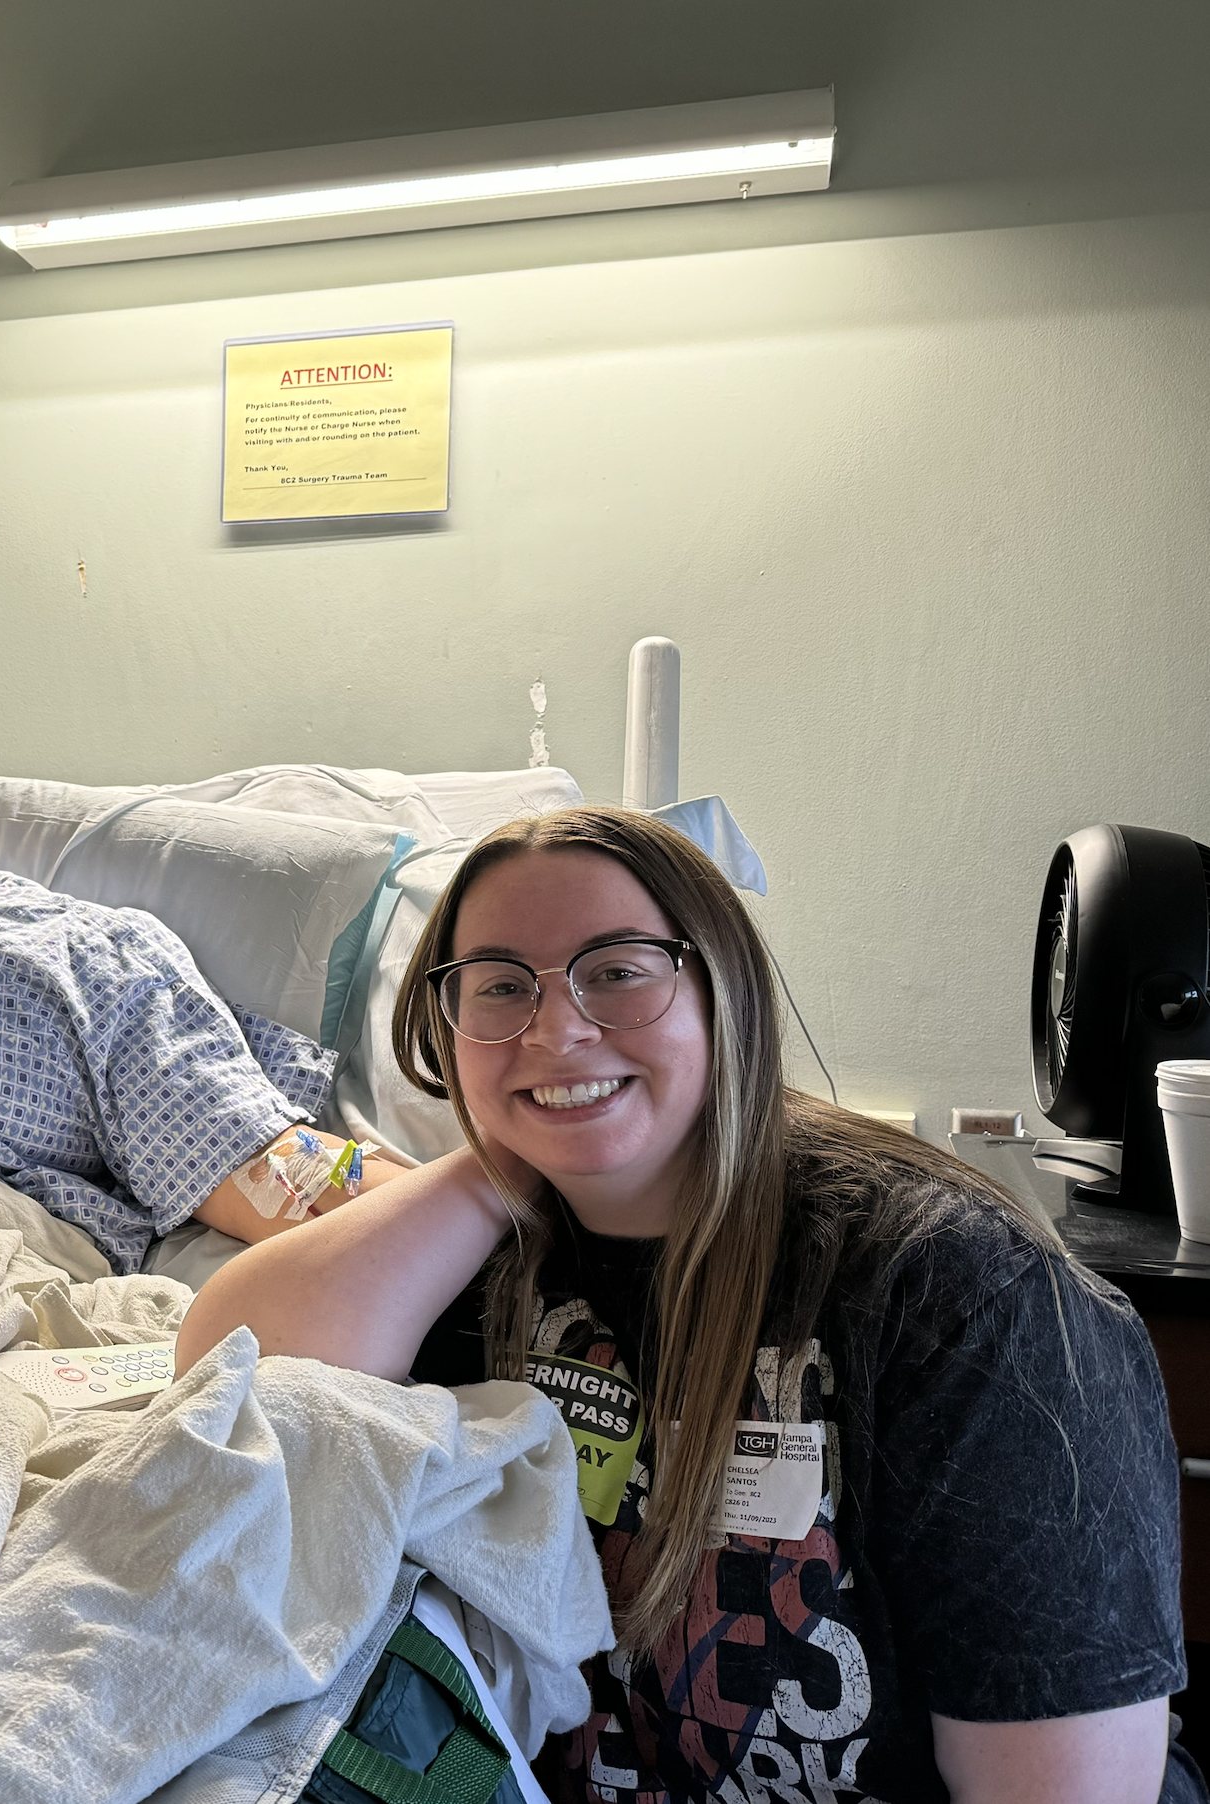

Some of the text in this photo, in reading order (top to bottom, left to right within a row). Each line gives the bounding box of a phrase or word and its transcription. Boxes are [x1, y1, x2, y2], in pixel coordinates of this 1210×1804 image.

[280, 362, 392, 387] ATTENTION:
[245, 406, 407, 424] For continuity of communication, please
[245, 427, 268, 435] notify
[321, 421, 350, 430] Charge
[352, 420, 376, 428] Nurse
[378, 418, 401, 426] when
[245, 438, 274, 446] visiting
[276, 436, 293, 444] with
[322, 432, 358, 441] rounding
[372, 430, 386, 438] the
[388, 428, 421, 438] patient.
[244, 464, 289, 473] Thank You,
[280, 476, 296, 484] 8C2
[331, 473, 362, 481] Trauma
[525, 1363, 637, 1409] ERNIGHT
[569, 1401, 630, 1434] PASS
[742, 1435, 775, 1449] TGH
[782, 1433, 812, 1443] Tampa
[781, 1441, 817, 1452] General
[576, 1444, 613, 1468] AY
[780, 1451, 820, 1462] Hospital
[727, 1465, 759, 1475] CHELSEA
[726, 1476, 757, 1486] SANTOS
[740, 1514, 777, 1524] 11/09/2023
